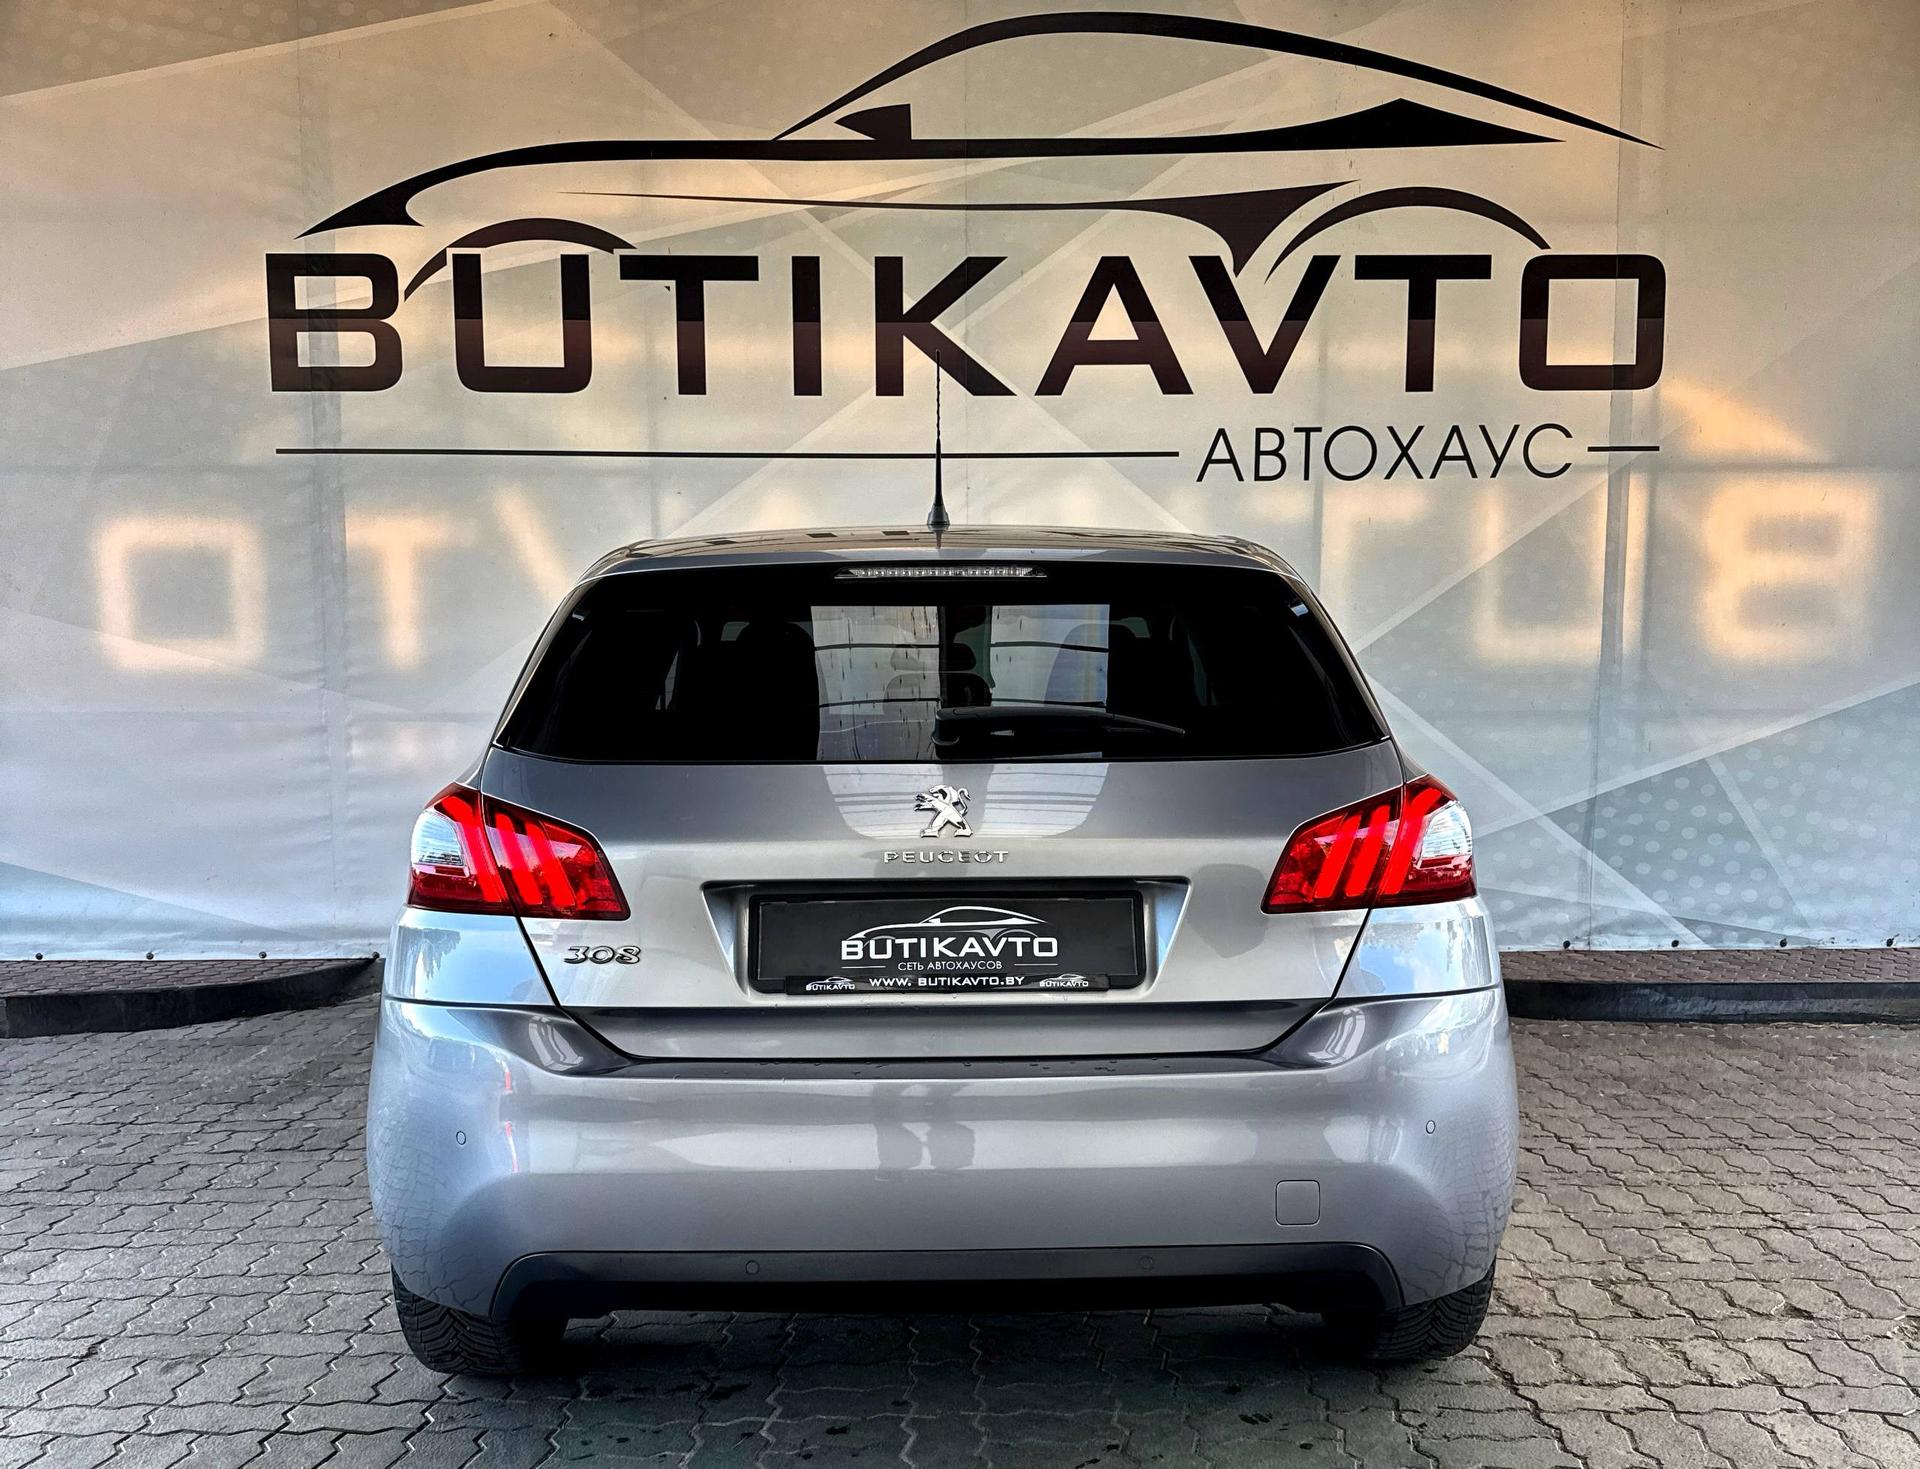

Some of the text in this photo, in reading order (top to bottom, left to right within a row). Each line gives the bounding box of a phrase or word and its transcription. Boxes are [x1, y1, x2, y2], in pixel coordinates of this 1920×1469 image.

[265, 252, 1667, 397] BUTIKAVTO
[1196, 422, 1573, 482] АВТОХАУС
[883, 850, 1009, 864] PEUGEOT
[563, 945, 641, 964] 308
[841, 936, 1058, 960] BUTIKAVTO
[897, 960, 1003, 971] СЕТЬ АВТОХАУСОВ
[805, 983, 856, 991] BUTIKAVTO
[869, 975, 1025, 987] WWW. BUTIKAVTO.BY
[1039, 980, 1089, 988] BUTIKAVTO
